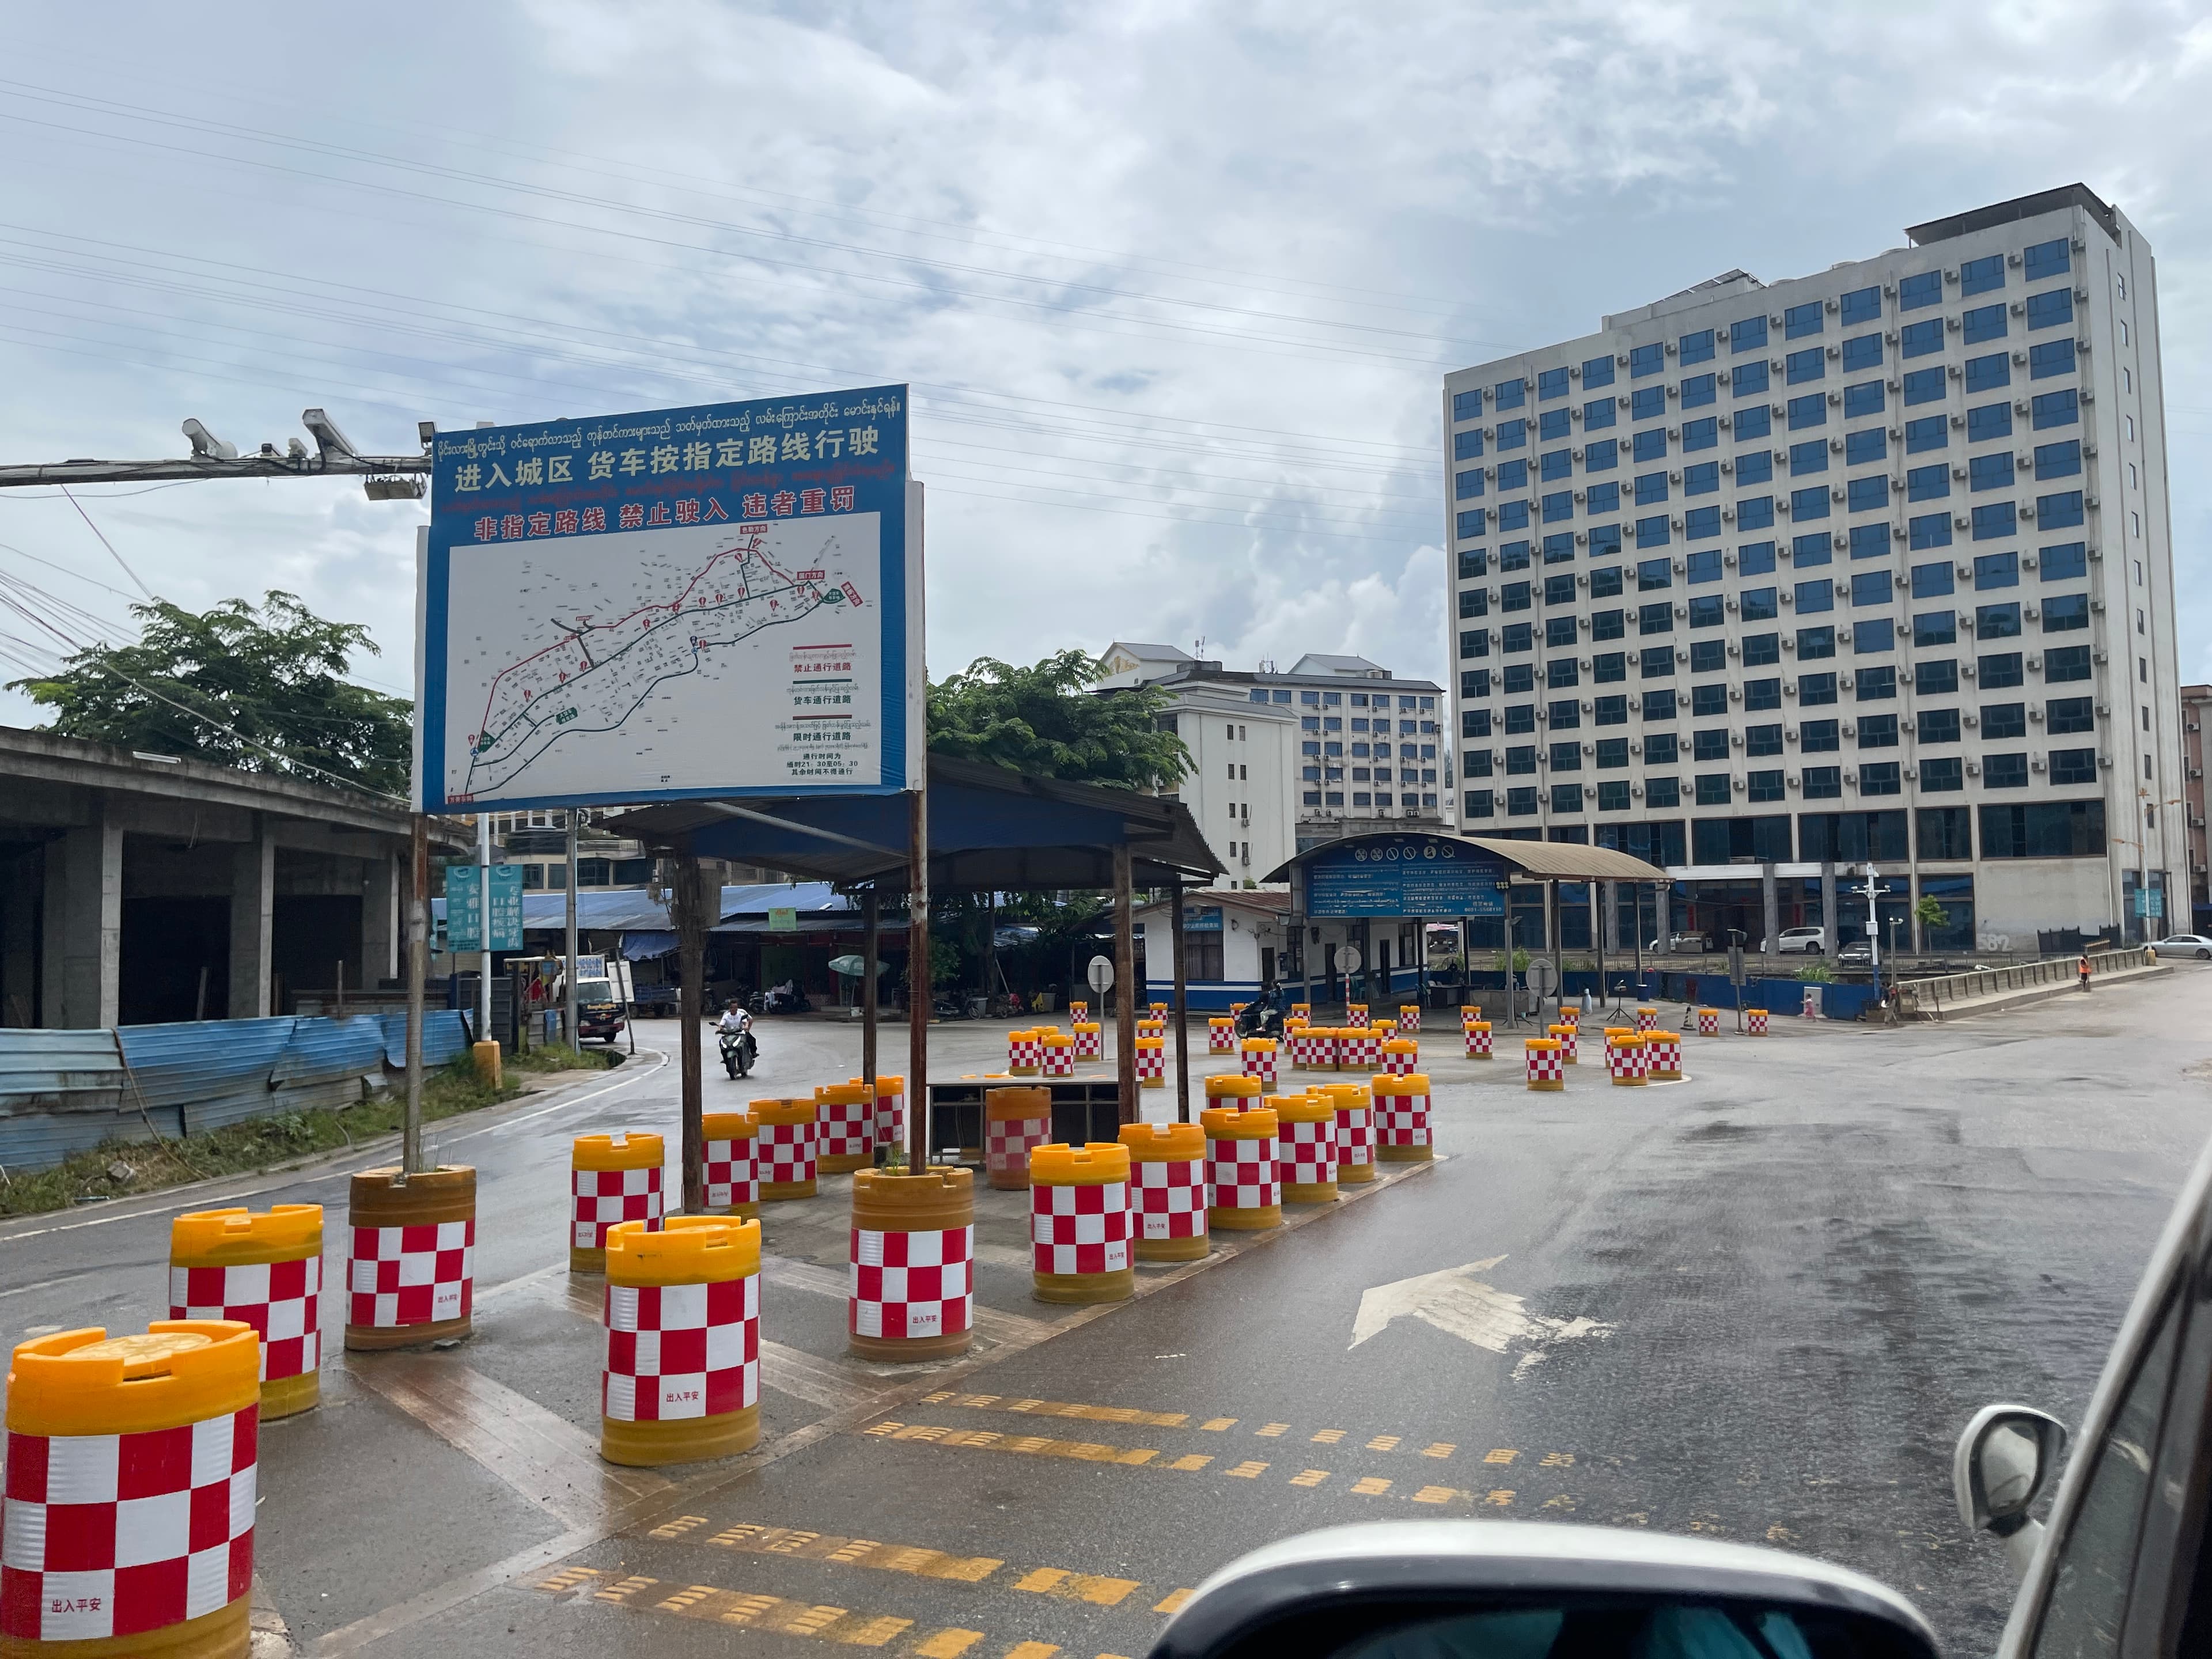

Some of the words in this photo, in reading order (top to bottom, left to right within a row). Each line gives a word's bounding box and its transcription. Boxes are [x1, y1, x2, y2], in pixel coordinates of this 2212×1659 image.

[454, 455, 573, 493] 进入城区
[588, 425, 879, 480] 货车按指定路线行驶
[474, 507, 606, 541] 非指定路线
[619, 497, 729, 529] 禁止驶入
[742, 486, 854, 518] 违者重罚
[794, 662, 851, 673] 禁止通行道路
[794, 695, 851, 706] 货车通行道路
[793, 732, 851, 741] 限时通行道路
[791, 768, 853, 776] 其余时间不得通行
[912, 1315, 936, 1324] 出入平安
[666, 1391, 699, 1402] 出入平安
[51, 1598, 102, 1613] 出入平安
